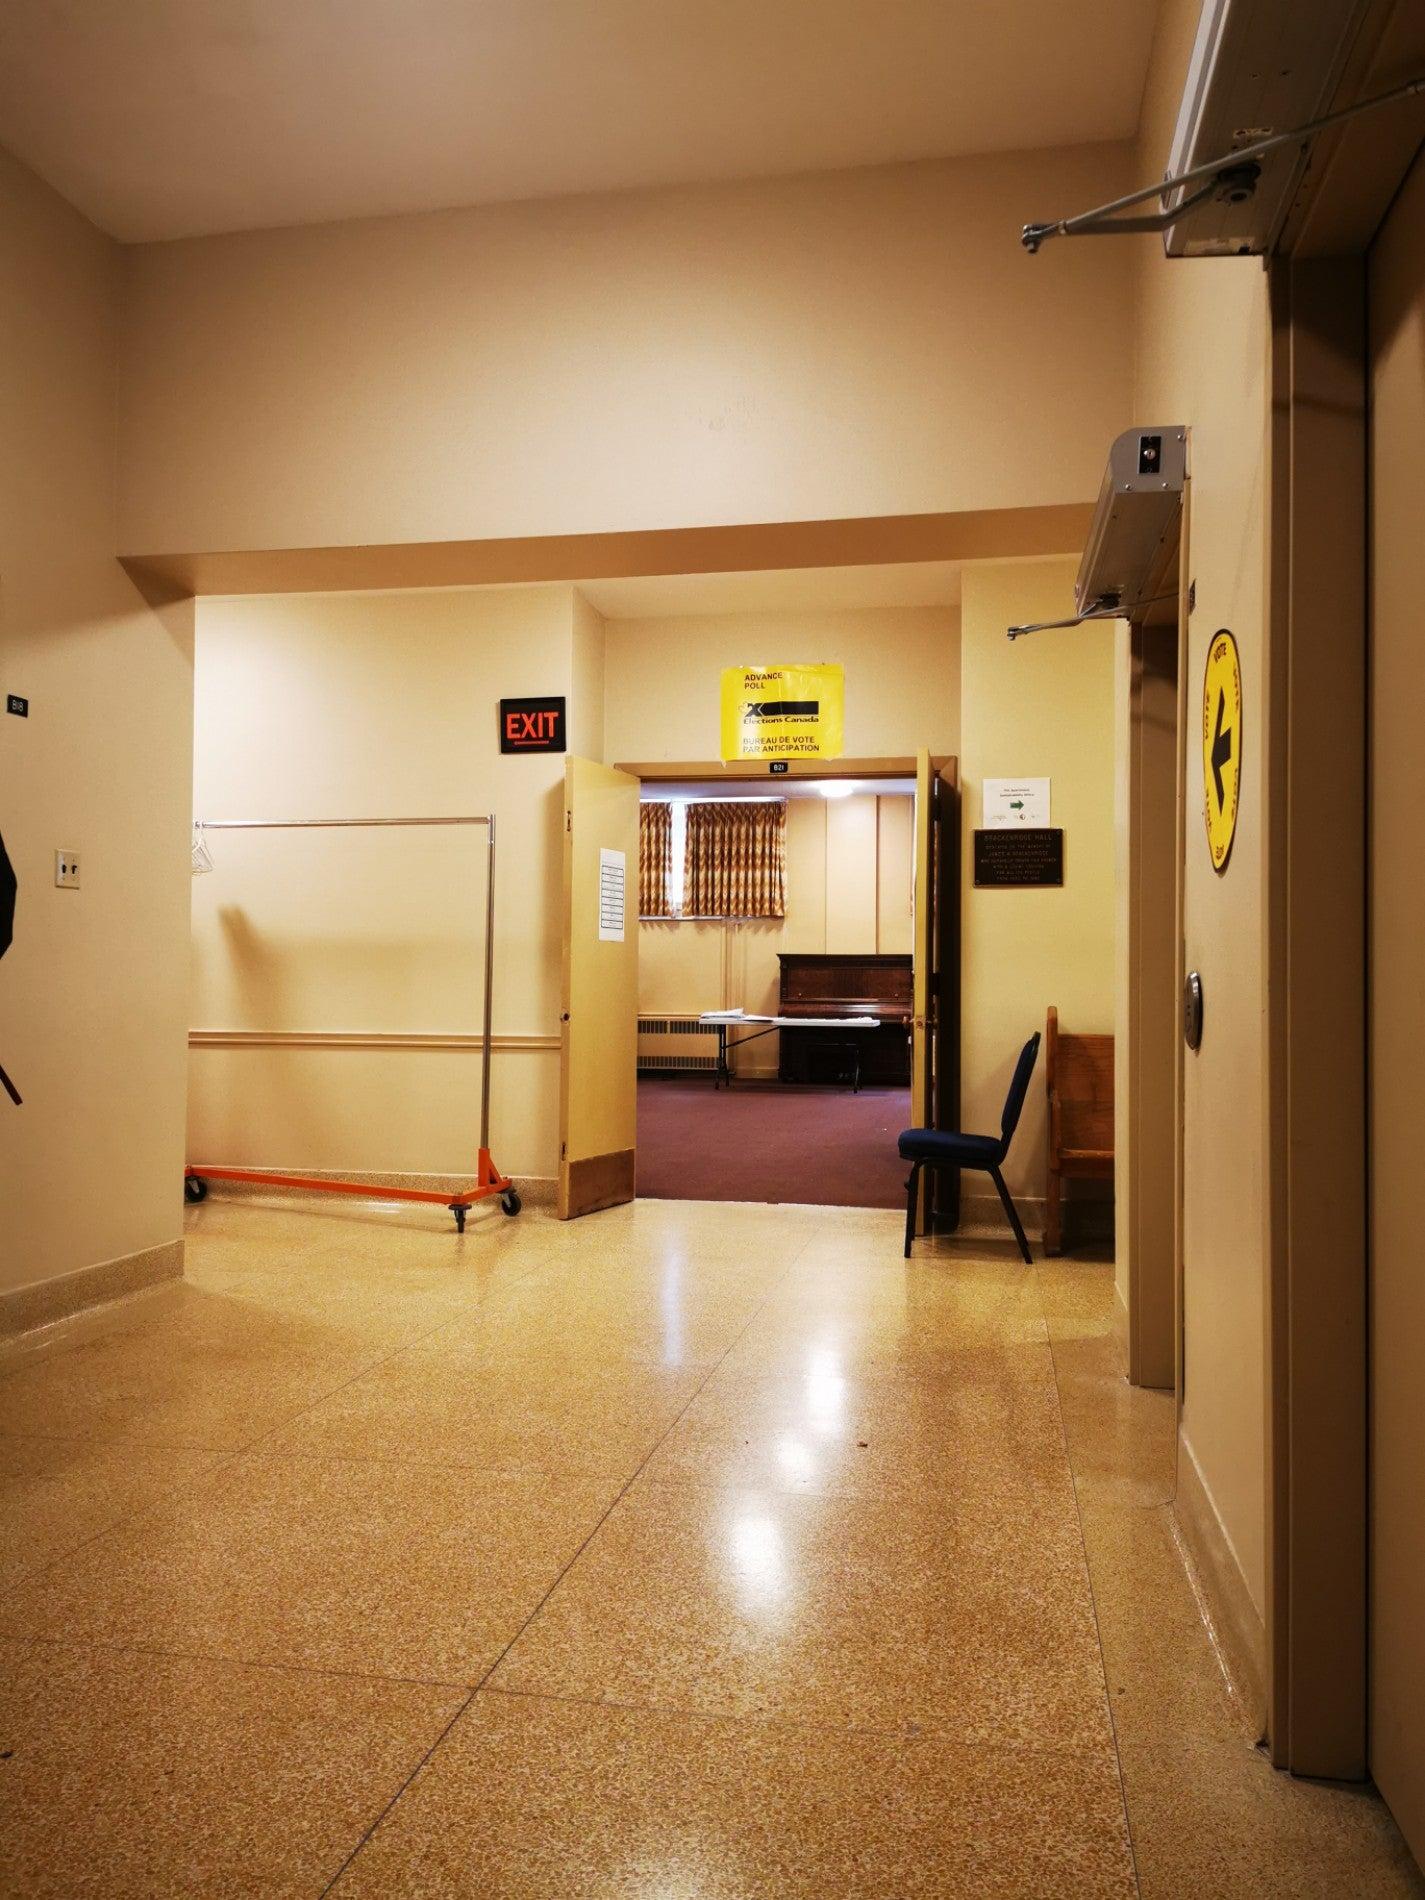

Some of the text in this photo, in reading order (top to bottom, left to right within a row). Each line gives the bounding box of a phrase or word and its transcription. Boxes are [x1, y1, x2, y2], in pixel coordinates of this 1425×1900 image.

[745, 672, 783, 681] ADVANCE
[744, 682, 766, 690] POLL
[784, 715, 819, 723] Canada
[506, 711, 559, 739] EXIT
[743, 736, 815, 745] BUREAU DE VOTE
[743, 744, 820, 753] PAR ANTICIPATION
